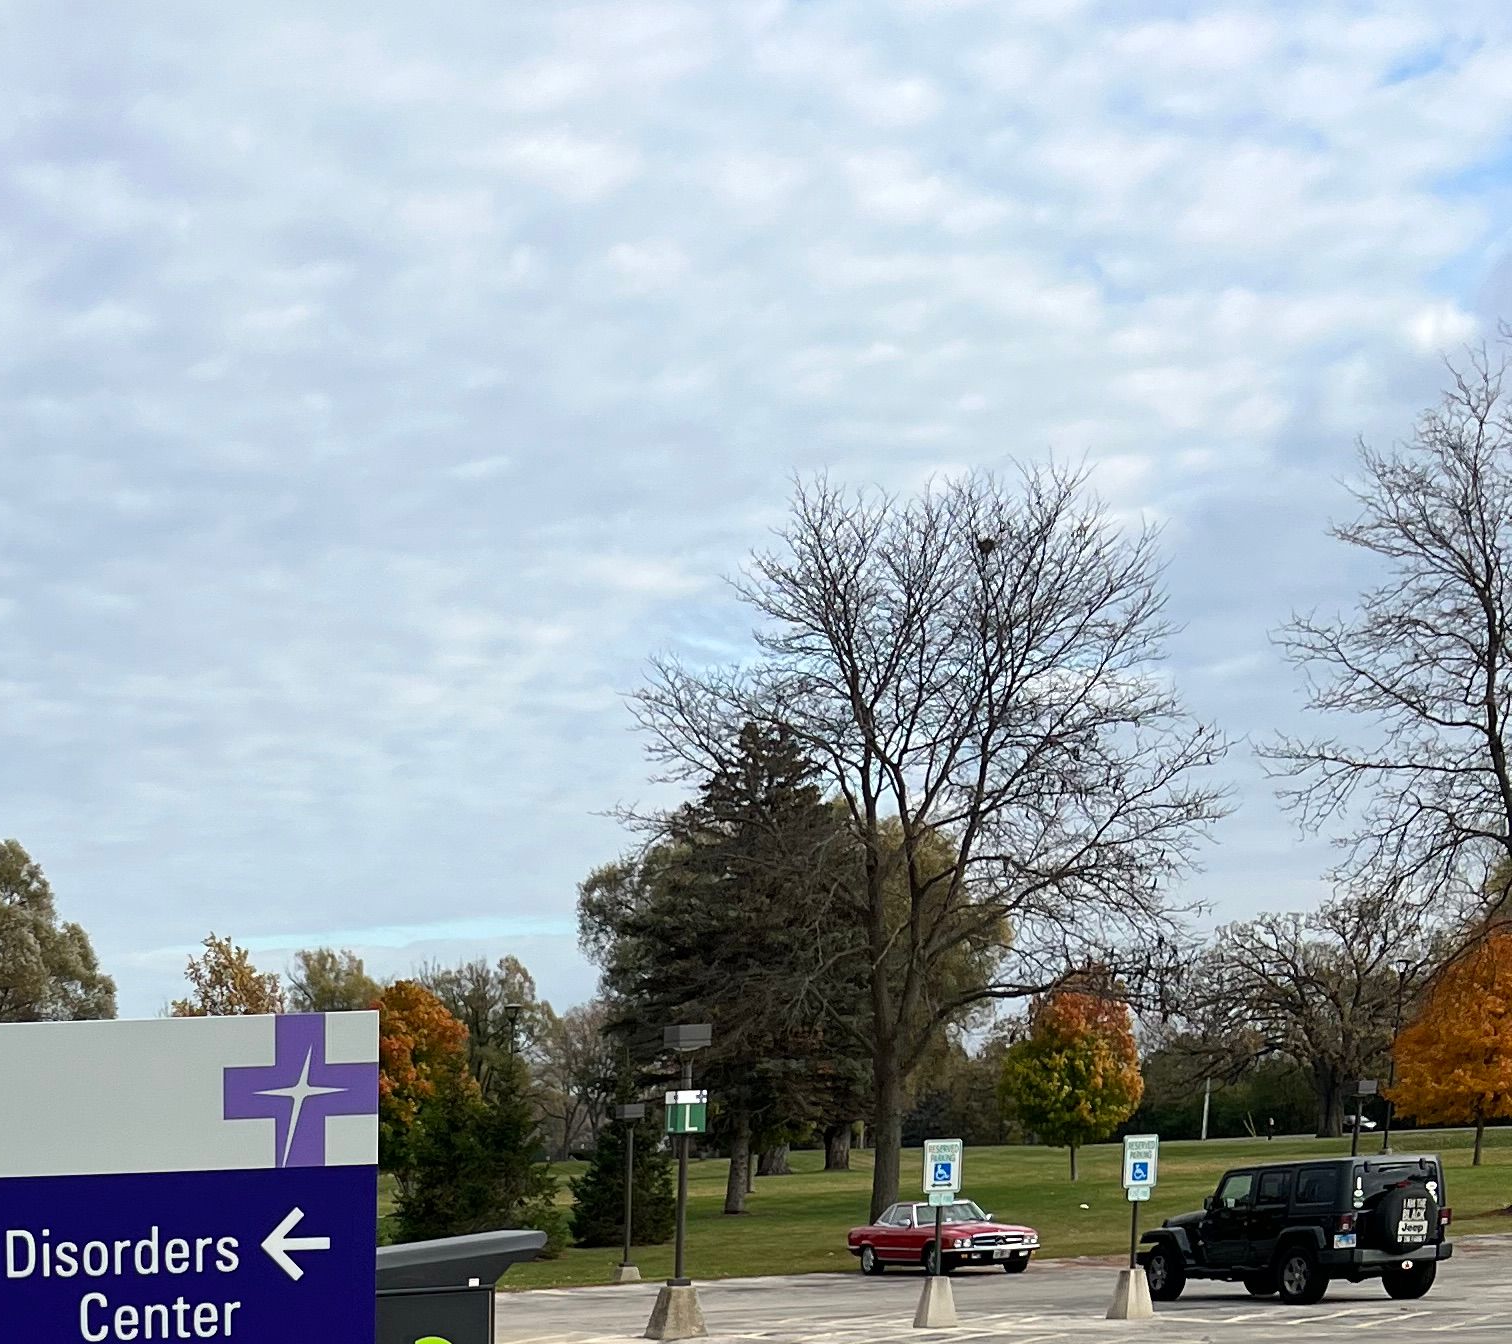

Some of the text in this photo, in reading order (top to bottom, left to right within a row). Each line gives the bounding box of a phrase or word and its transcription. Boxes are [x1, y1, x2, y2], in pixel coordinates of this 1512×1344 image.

[685, 1104, 698, 1131] L
[1401, 1222, 1424, 1233] Jeep
[1402, 1208, 1426, 1220] BLACK
[6, 1225, 239, 1279] Disorders
[80, 1292, 241, 1342] Center
